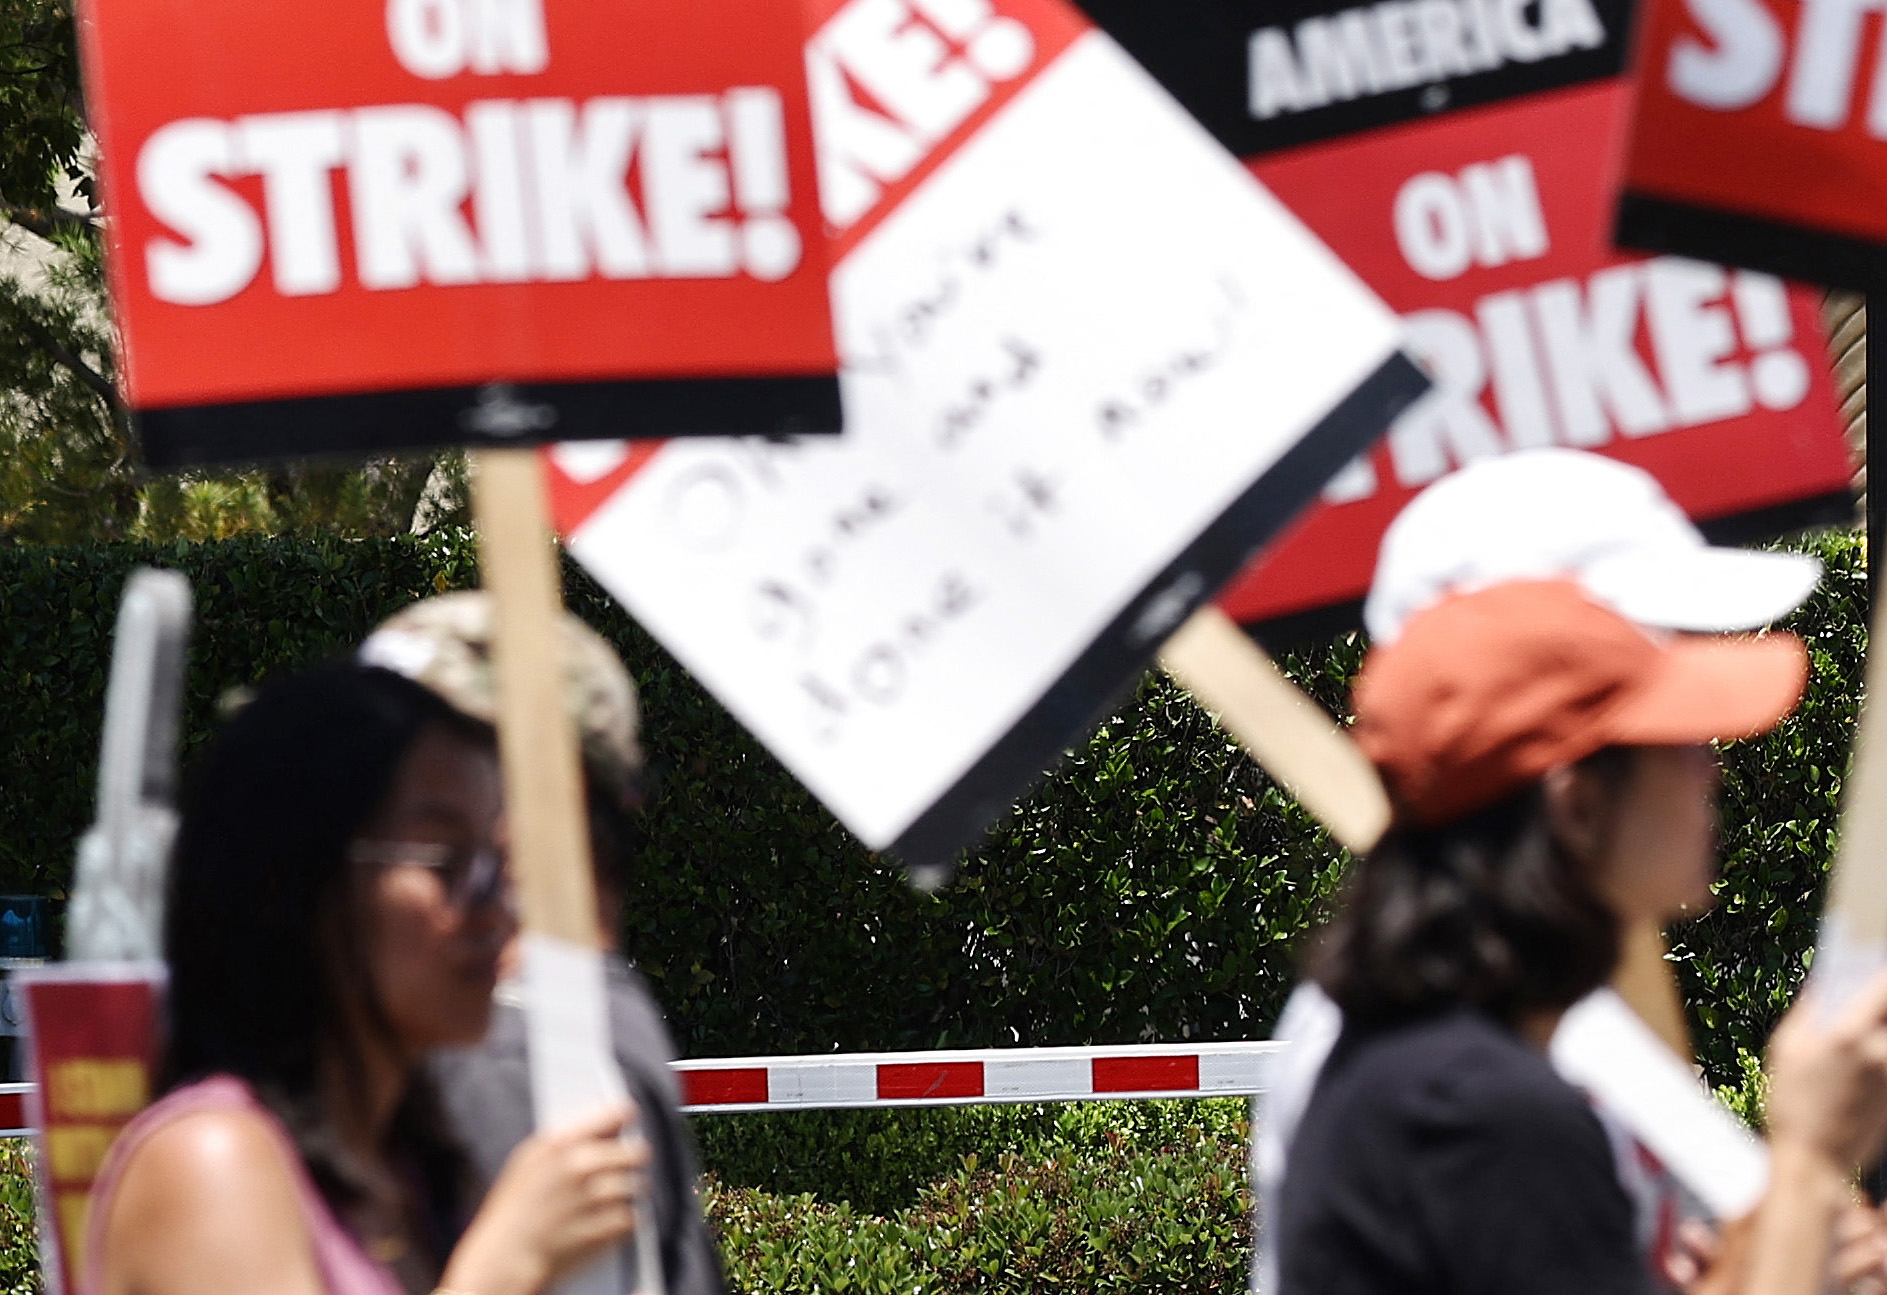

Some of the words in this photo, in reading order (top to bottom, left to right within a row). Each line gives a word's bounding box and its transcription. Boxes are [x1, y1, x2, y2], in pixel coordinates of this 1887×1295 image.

[139, 89, 800, 302] STRIKE!
[1396, 158, 1546, 278] ON
[1323, 259, 1807, 502] RIKE!
